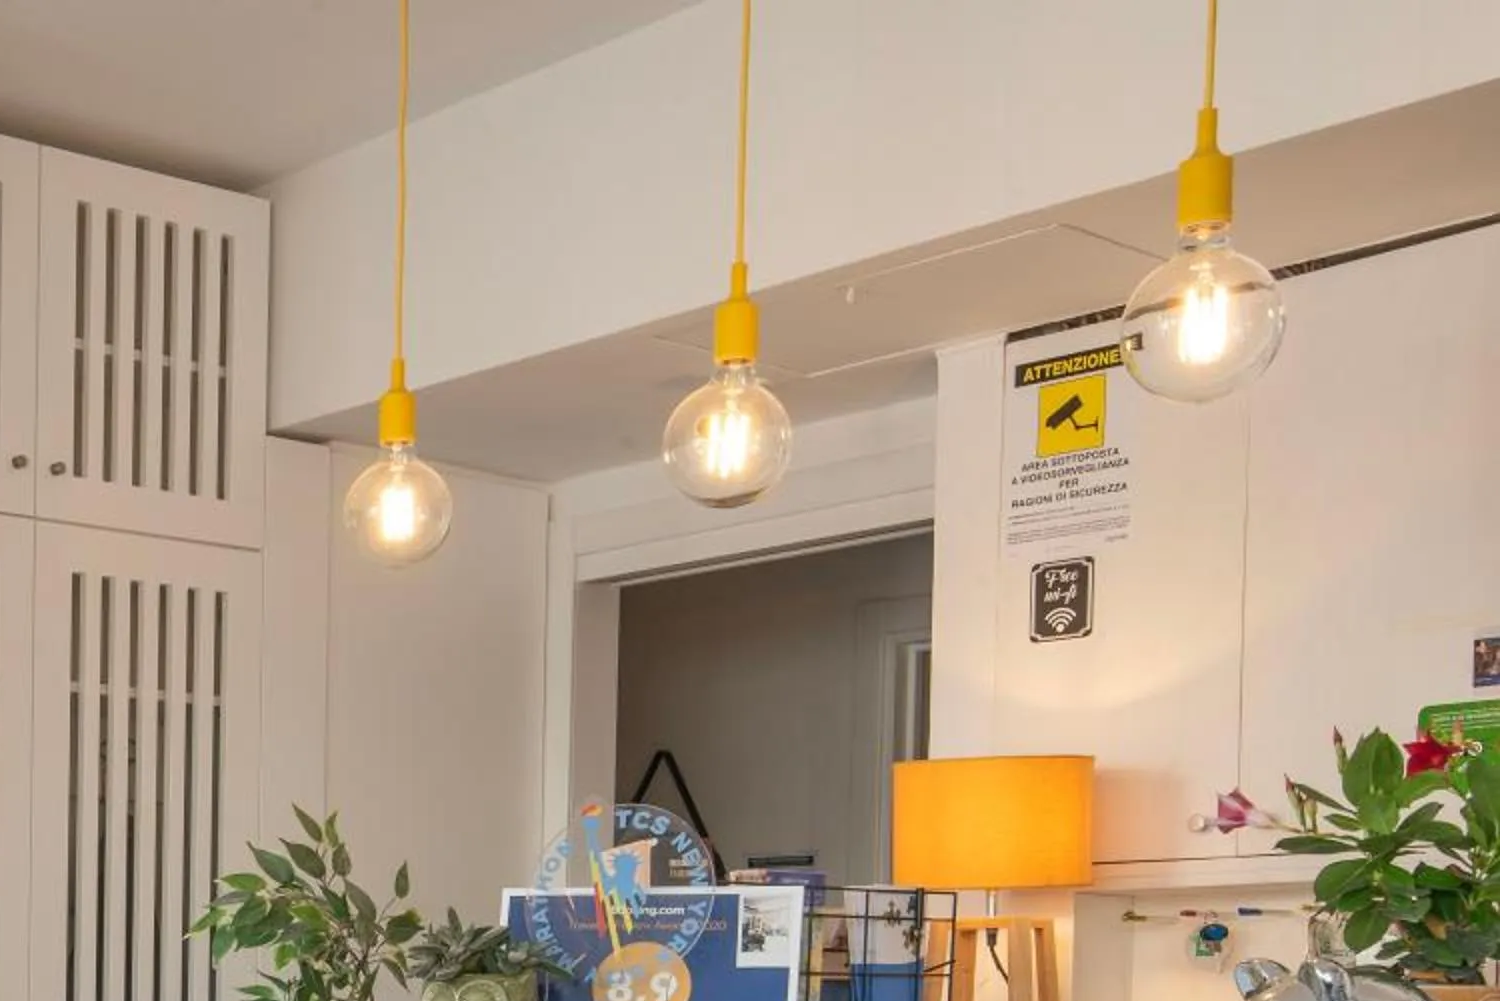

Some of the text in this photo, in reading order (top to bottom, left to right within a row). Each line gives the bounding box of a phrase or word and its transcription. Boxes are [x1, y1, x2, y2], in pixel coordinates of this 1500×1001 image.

[1023, 348, 1121, 383] ATTENZIONE
[1021, 447, 1120, 473] AREA SOTTOPOSTA
[615, 810, 671, 835] TCS
[671, 831, 708, 887] NEW
